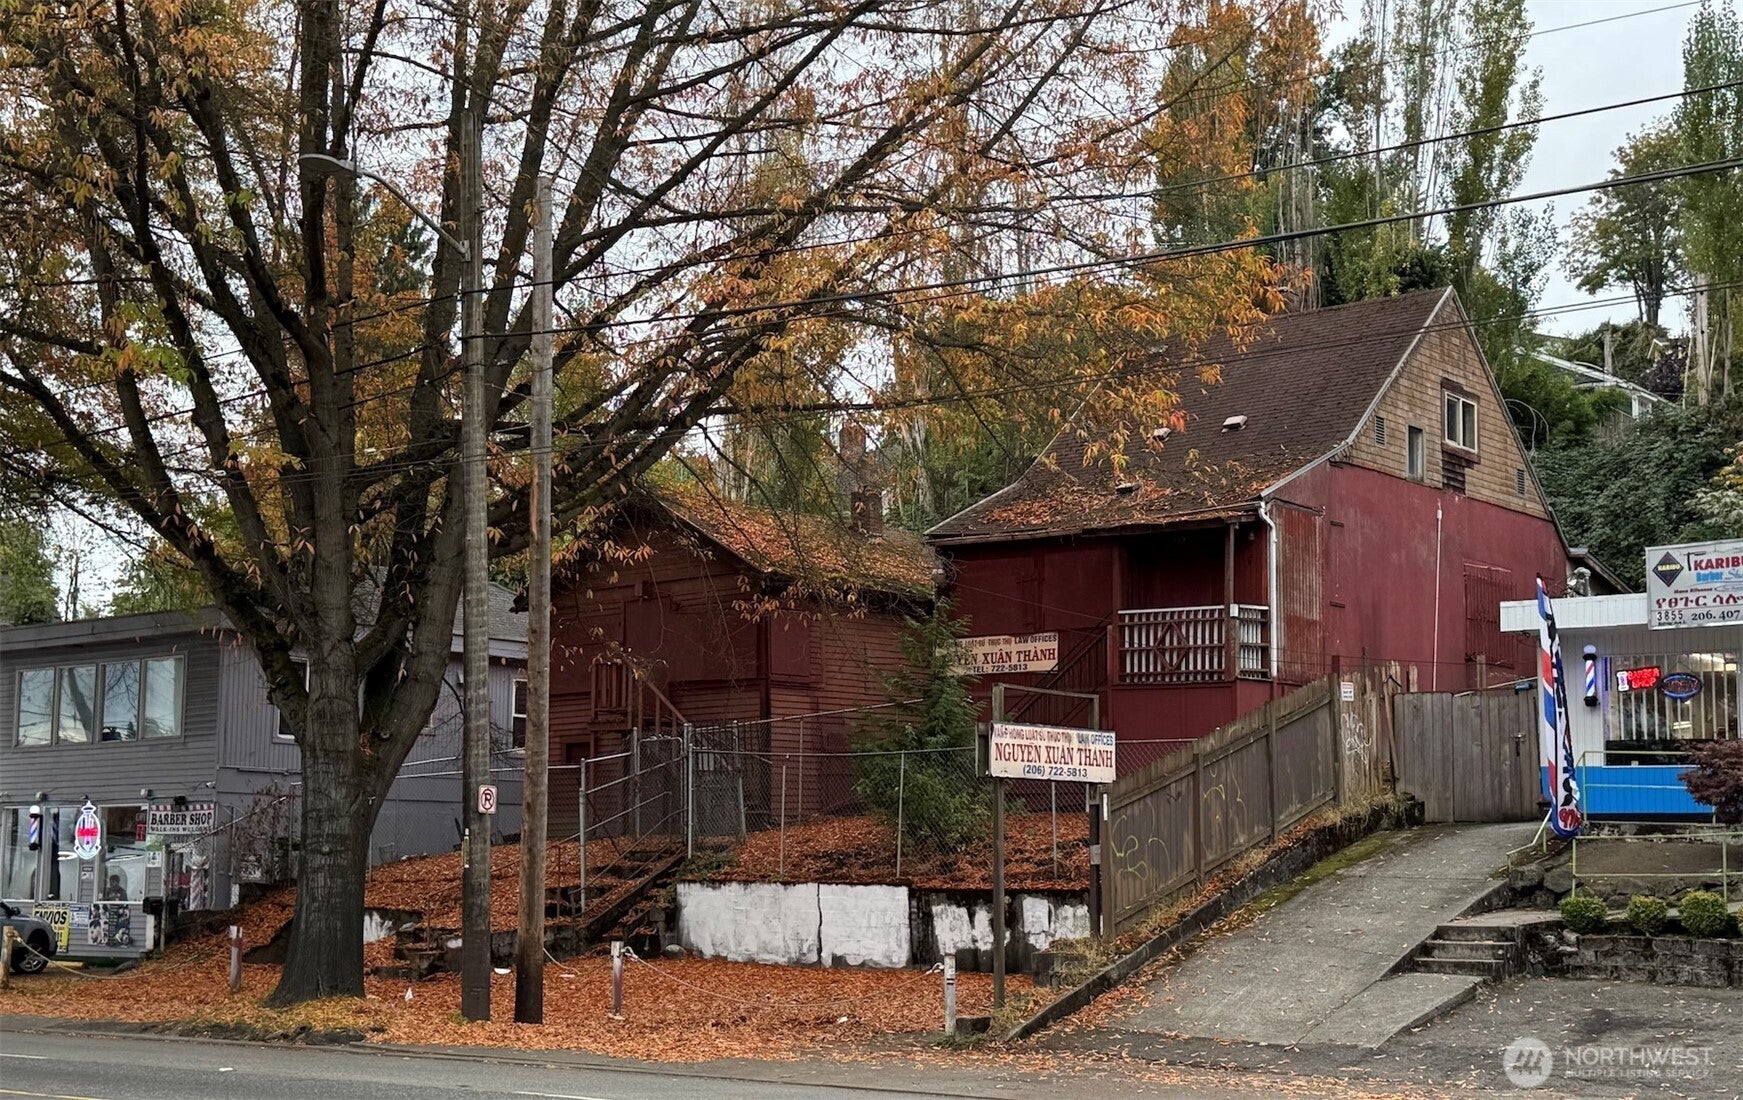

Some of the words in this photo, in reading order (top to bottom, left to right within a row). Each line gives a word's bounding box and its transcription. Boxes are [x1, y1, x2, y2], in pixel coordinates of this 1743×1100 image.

[1694, 555, 1743, 571] KARIB
[1657, 610, 1683, 621] 3855
[1014, 636, 1029, 645] LAW
[1031, 634, 1057, 644] OFFICES
[982, 649, 1013, 665] XUÂN
[1016, 646, 1056, 663] THÀNH
[991, 663, 1028, 673] 722-5813
[1628, 667, 1660, 680] BARBER
[1632, 676, 1657, 689] SHOP
[1091, 733, 1114, 746] OFFICES
[1023, 764, 1046, 777] (206)
[1048, 766, 1088, 778] 722-5813
[151, 813, 187, 826] BARBER
[189, 812, 213, 826] SHOP
